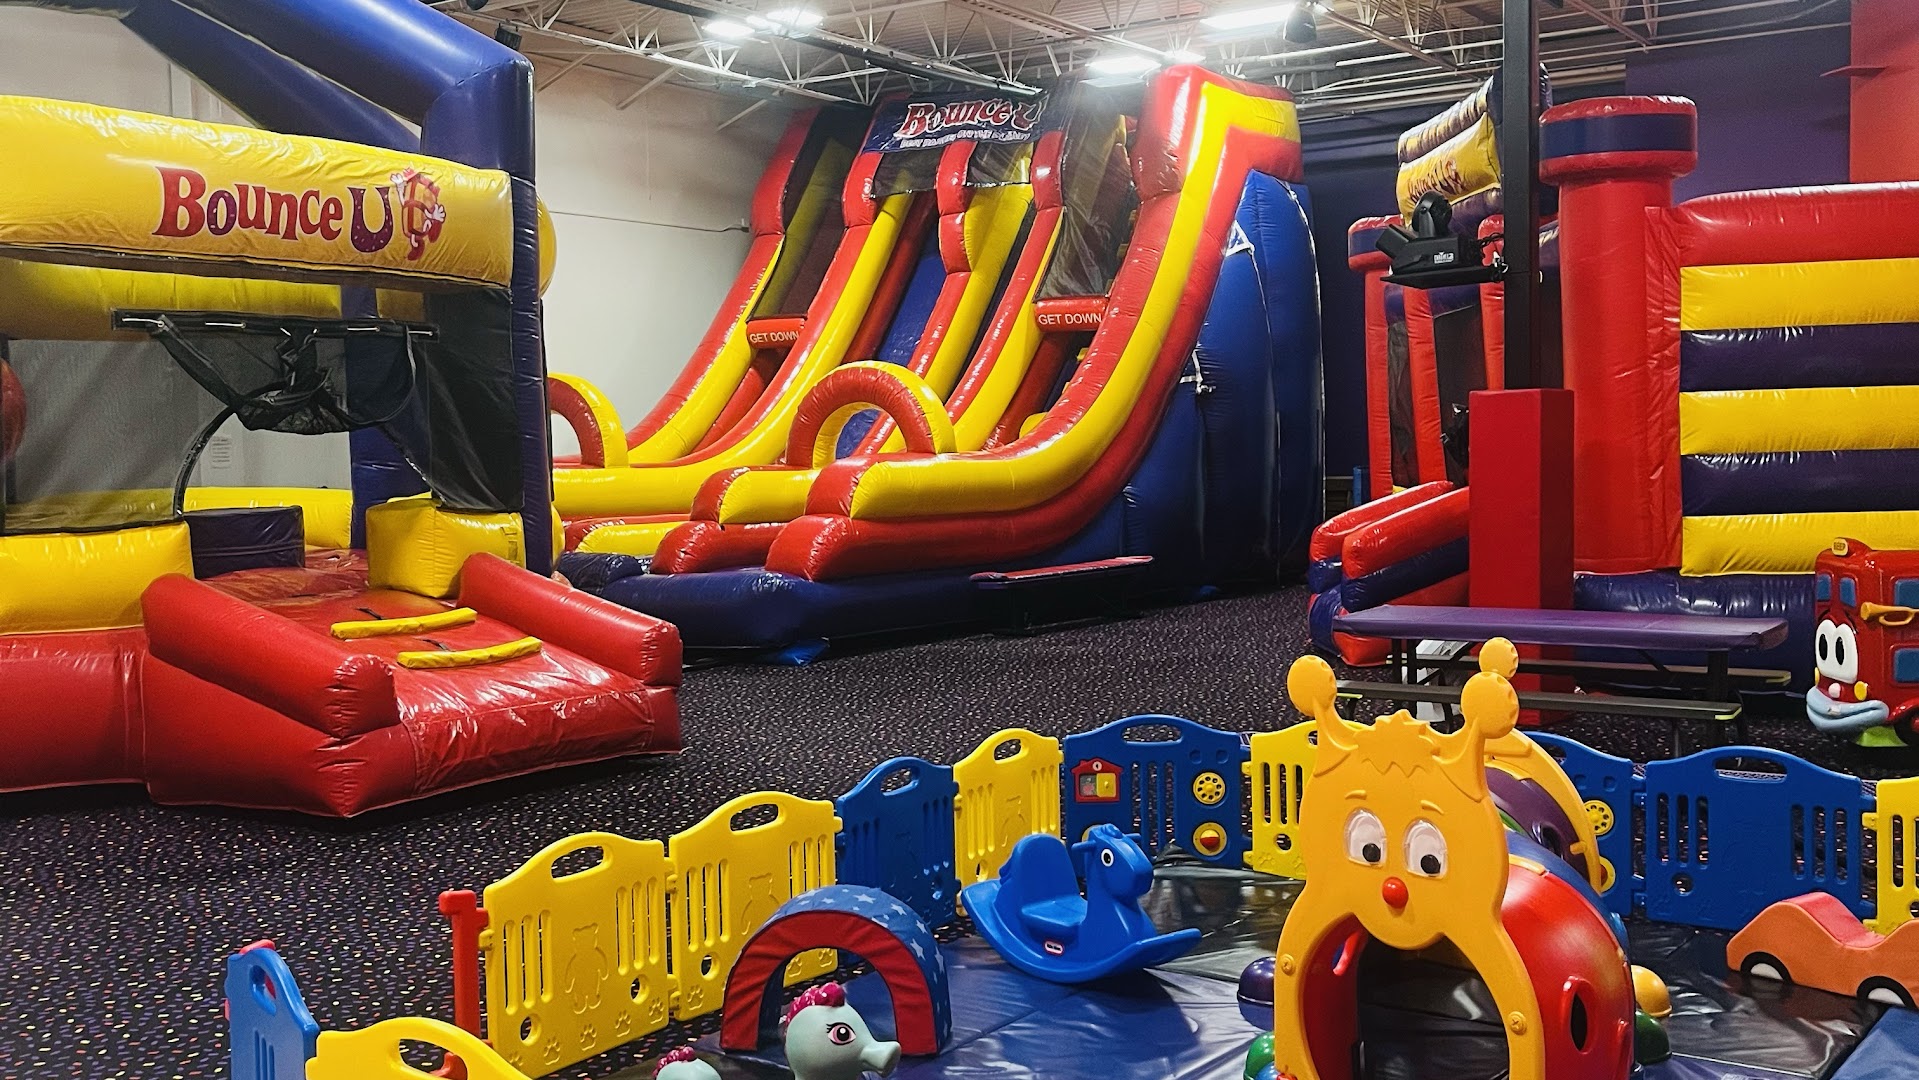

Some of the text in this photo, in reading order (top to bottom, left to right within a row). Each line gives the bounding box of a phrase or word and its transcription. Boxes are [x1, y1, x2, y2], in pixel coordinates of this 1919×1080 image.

[895, 91, 1050, 139] Bounce U
[151, 166, 394, 253] Bounce U
[1038, 313, 1102, 325] GET DOWN
[750, 331, 799, 343] GET DOWN
